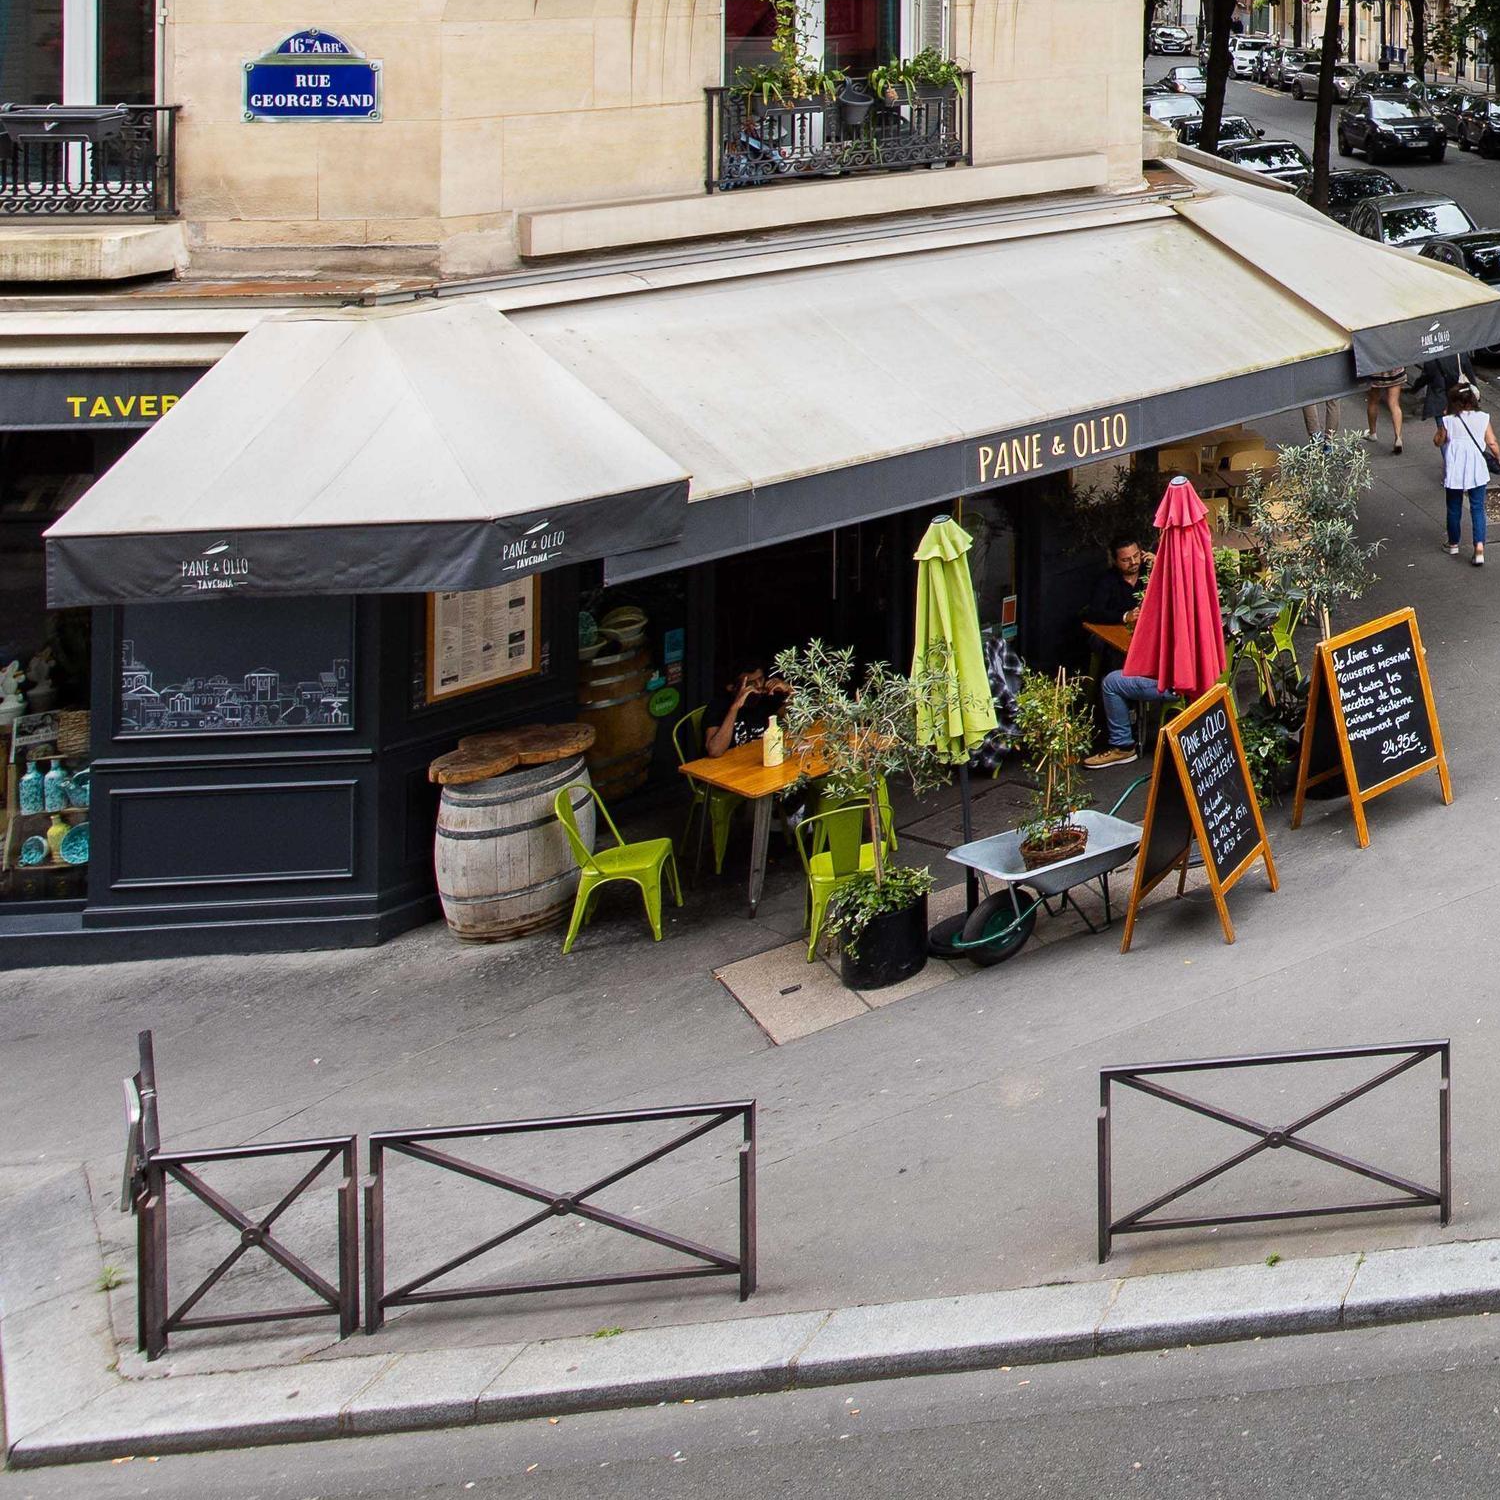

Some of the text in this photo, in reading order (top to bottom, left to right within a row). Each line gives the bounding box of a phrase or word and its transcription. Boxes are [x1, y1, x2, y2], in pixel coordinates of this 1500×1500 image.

[295, 74, 331, 87] RUE
[250, 94, 374, 107] GEORGE SAND
[978, 413, 1127, 482] PANE & OLIO
[503, 531, 565, 560] PANE & OLIO
[182, 558, 248, 577] PANE & OLIO
[516, 552, 548, 569] TAVERNA
[197, 579, 234, 590] TAVERNA
[1372, 644, 1385, 655] DE
[1358, 679, 1384, 694] toutes
[1180, 730, 1201, 761] PANE
[1381, 731, 1419, 755] 24,95€
